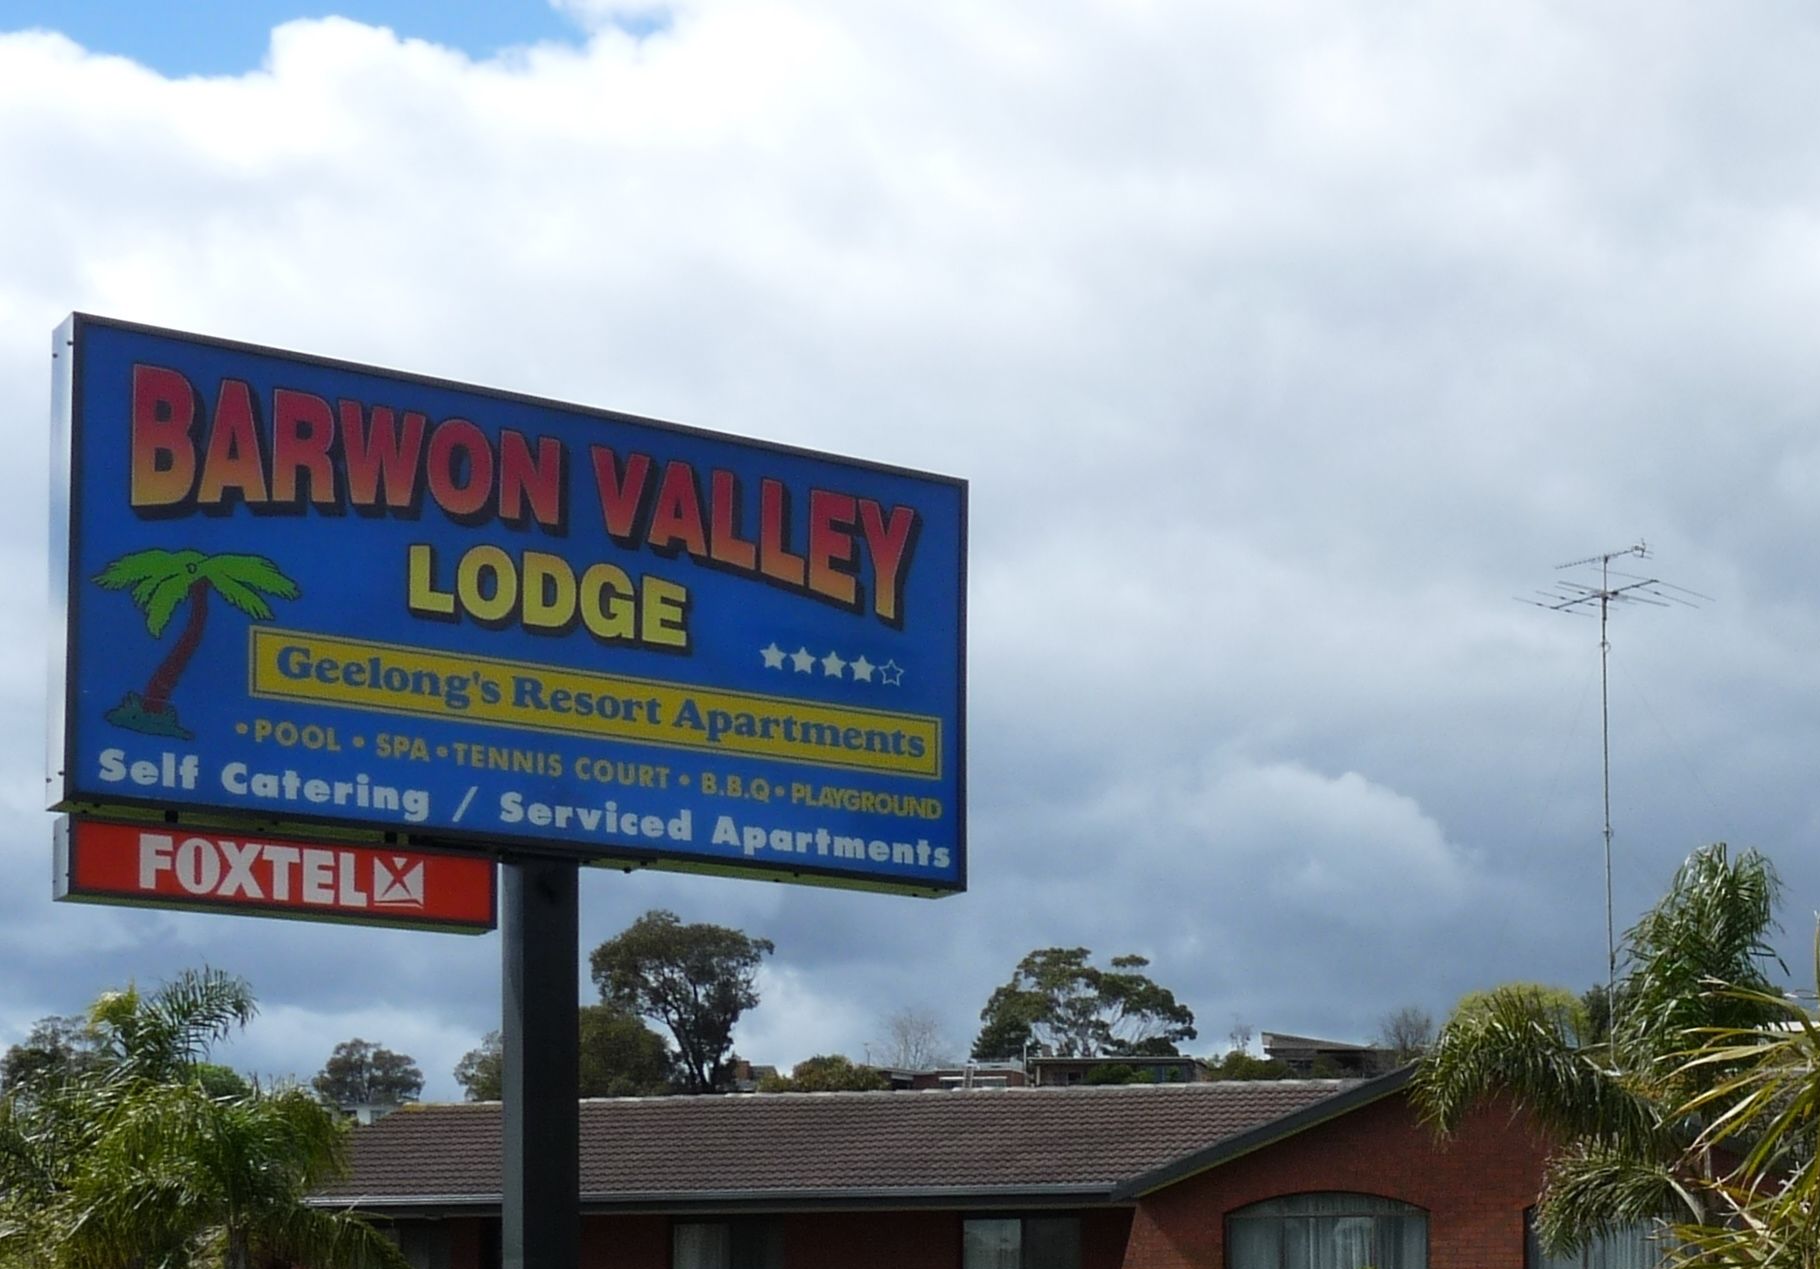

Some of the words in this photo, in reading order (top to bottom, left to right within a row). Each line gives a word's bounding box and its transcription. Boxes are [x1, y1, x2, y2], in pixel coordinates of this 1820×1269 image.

[131, 364, 561, 526] BARWON
[591, 446, 915, 620] VALLEY
[409, 545, 687, 647] LODGE
[276, 646, 502, 710] Geelong's
[512, 675, 662, 725] Resort
[671, 698, 926, 759] Apartments
[98, 748, 200, 790] Self
[220, 761, 430, 822] Catering
[500, 791, 693, 842] Serviced
[711, 815, 951, 869] Apartments
[254, 719, 341, 752] POOL
[375, 732, 431, 762] SPA
[452, 742, 563, 778] TENNIS
[575, 756, 671, 789] COURT
[791, 782, 943, 821] PLAYGROUND
[138, 833, 368, 908] FOXTEL
